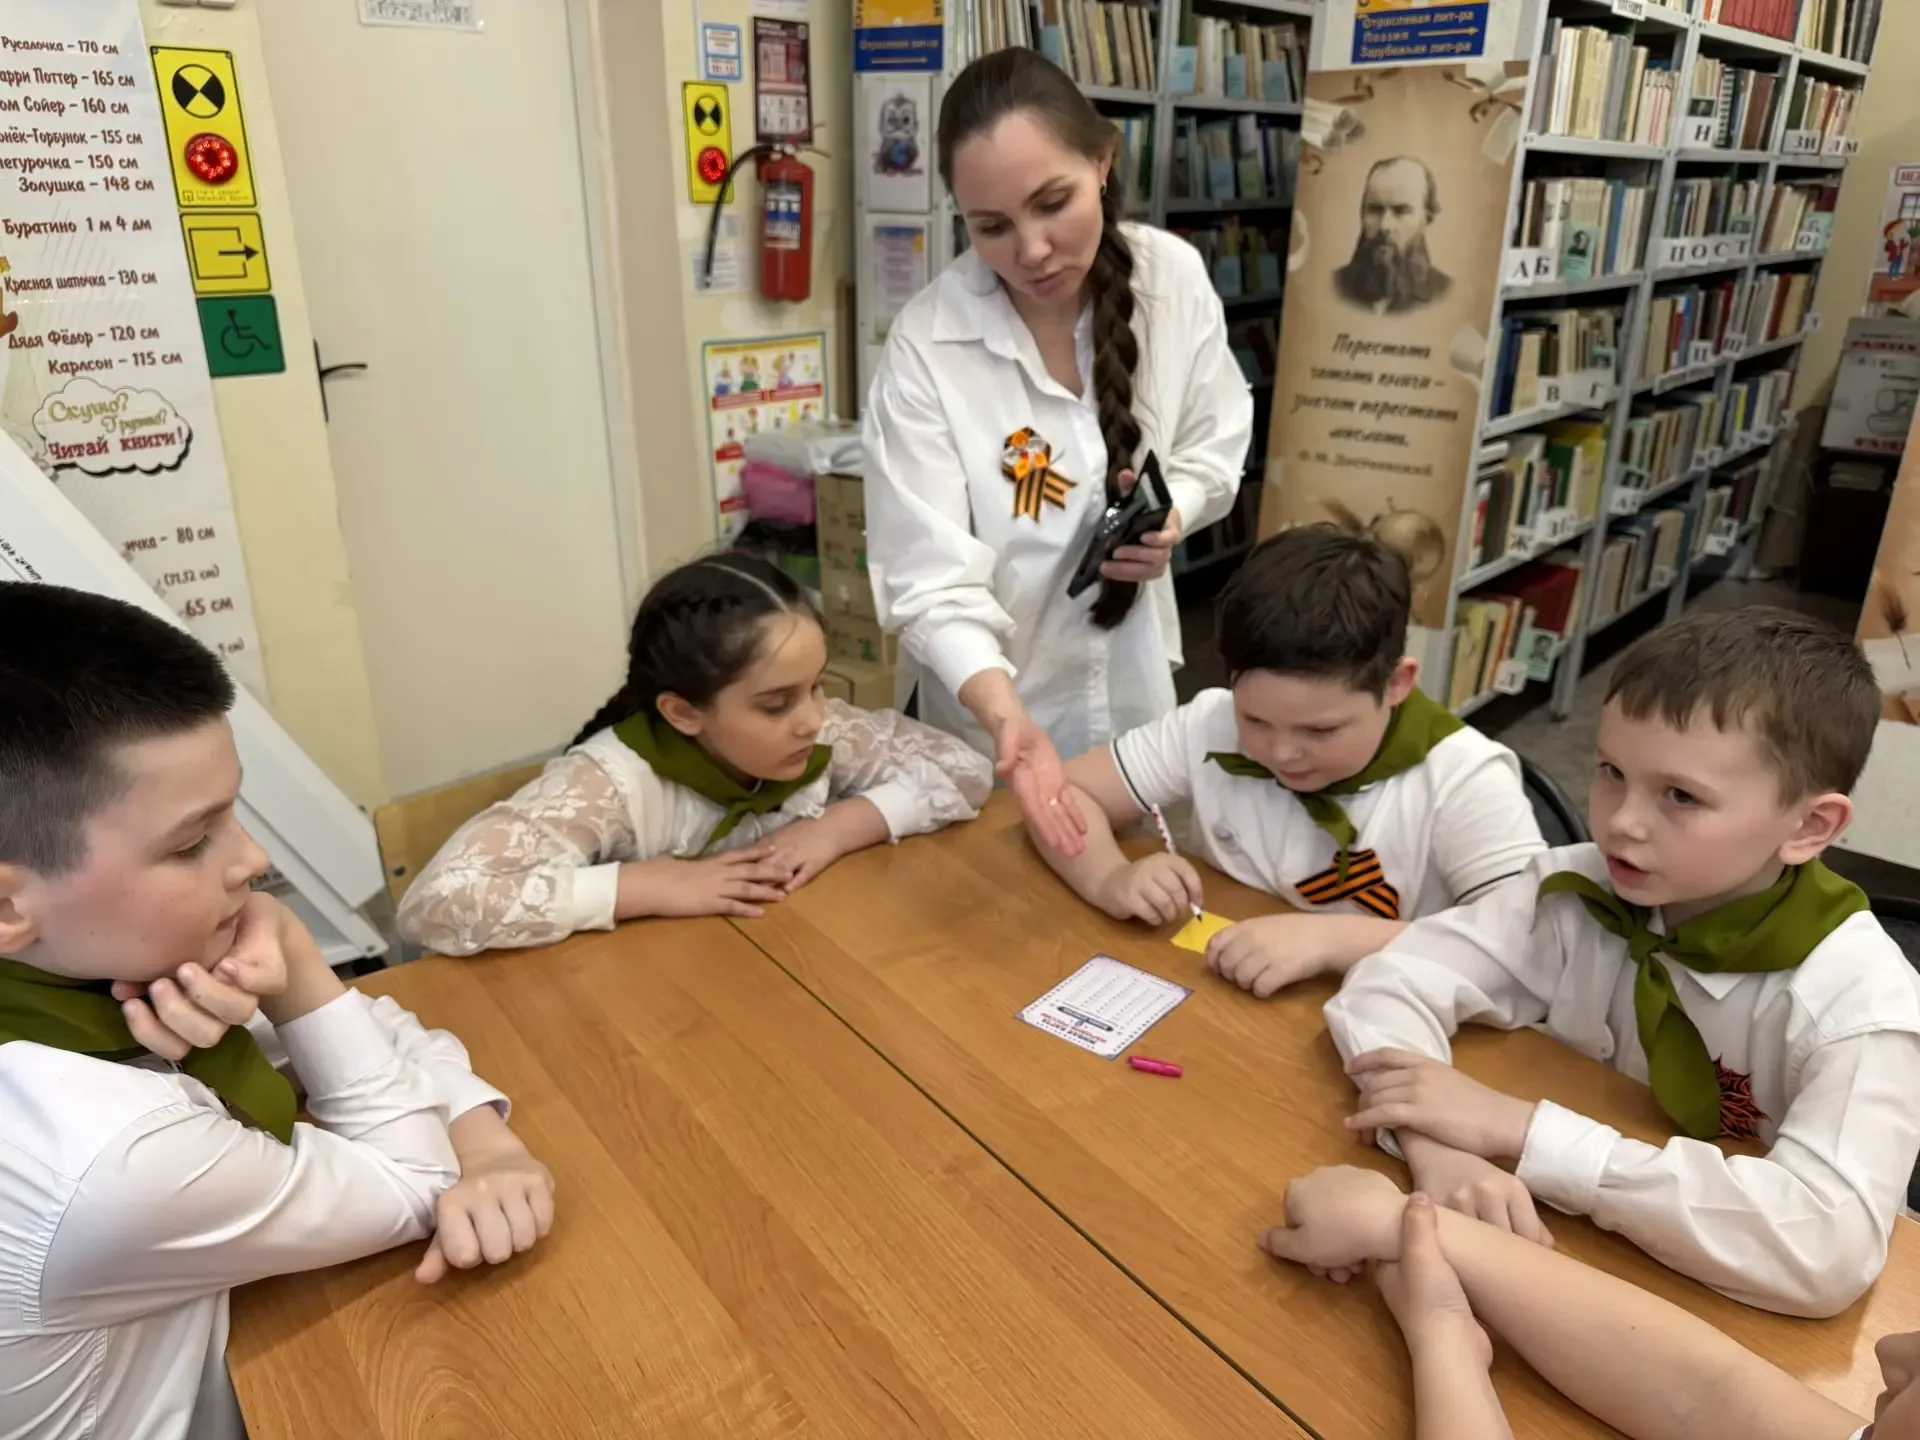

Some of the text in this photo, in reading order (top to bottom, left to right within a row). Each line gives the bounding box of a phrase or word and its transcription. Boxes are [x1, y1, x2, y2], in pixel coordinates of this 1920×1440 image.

[1, 36, 64, 52] Русалочка
[78, 40, 98, 53] 170
[102, 44, 119, 54] см
[0, 70, 31, 87] арри
[33, 67, 78, 88] Поттер
[93, 70, 114, 86] 165
[118, 76, 135, 87] см
[0, 99, 20, 112] ом
[24, 96, 65, 117] Сойер
[82, 98, 106, 114] 160
[111, 104, 130, 115] см
[0, 126, 88, 148] онёк-Горбунок
[101, 129, 122, 144] 155
[126, 132, 143, 144] см
[88, 155, 114, 169] 150
[119, 158, 139, 169] см
[18, 177, 86, 196] Золушка
[103, 176, 130, 191] 148
[135, 180, 155, 191] см
[3, 218, 77, 239] Буратино
[86, 217, 93, 232] 1
[99, 219, 112, 232] м
[116, 215, 127, 231] 4
[4, 276, 53, 296] Красная
[57, 275, 106, 289] шапочка
[119, 270, 138, 285] 130
[142, 271, 158, 284] см
[8, 334, 44, 350] Дядя
[48, 329, 93, 351] Фёдор
[110, 326, 136, 342] 120
[140, 327, 160, 340] см
[48, 357, 113, 376] Карлсон
[132, 351, 157, 366] 115
[161, 352, 183, 364] см
[48, 392, 129, 423] Скучно?
[48, 425, 183, 460] Читай книги!
[176, 527, 194, 544] 80
[197, 526, 215, 540] см
[186, 596, 234, 617] 65 см
